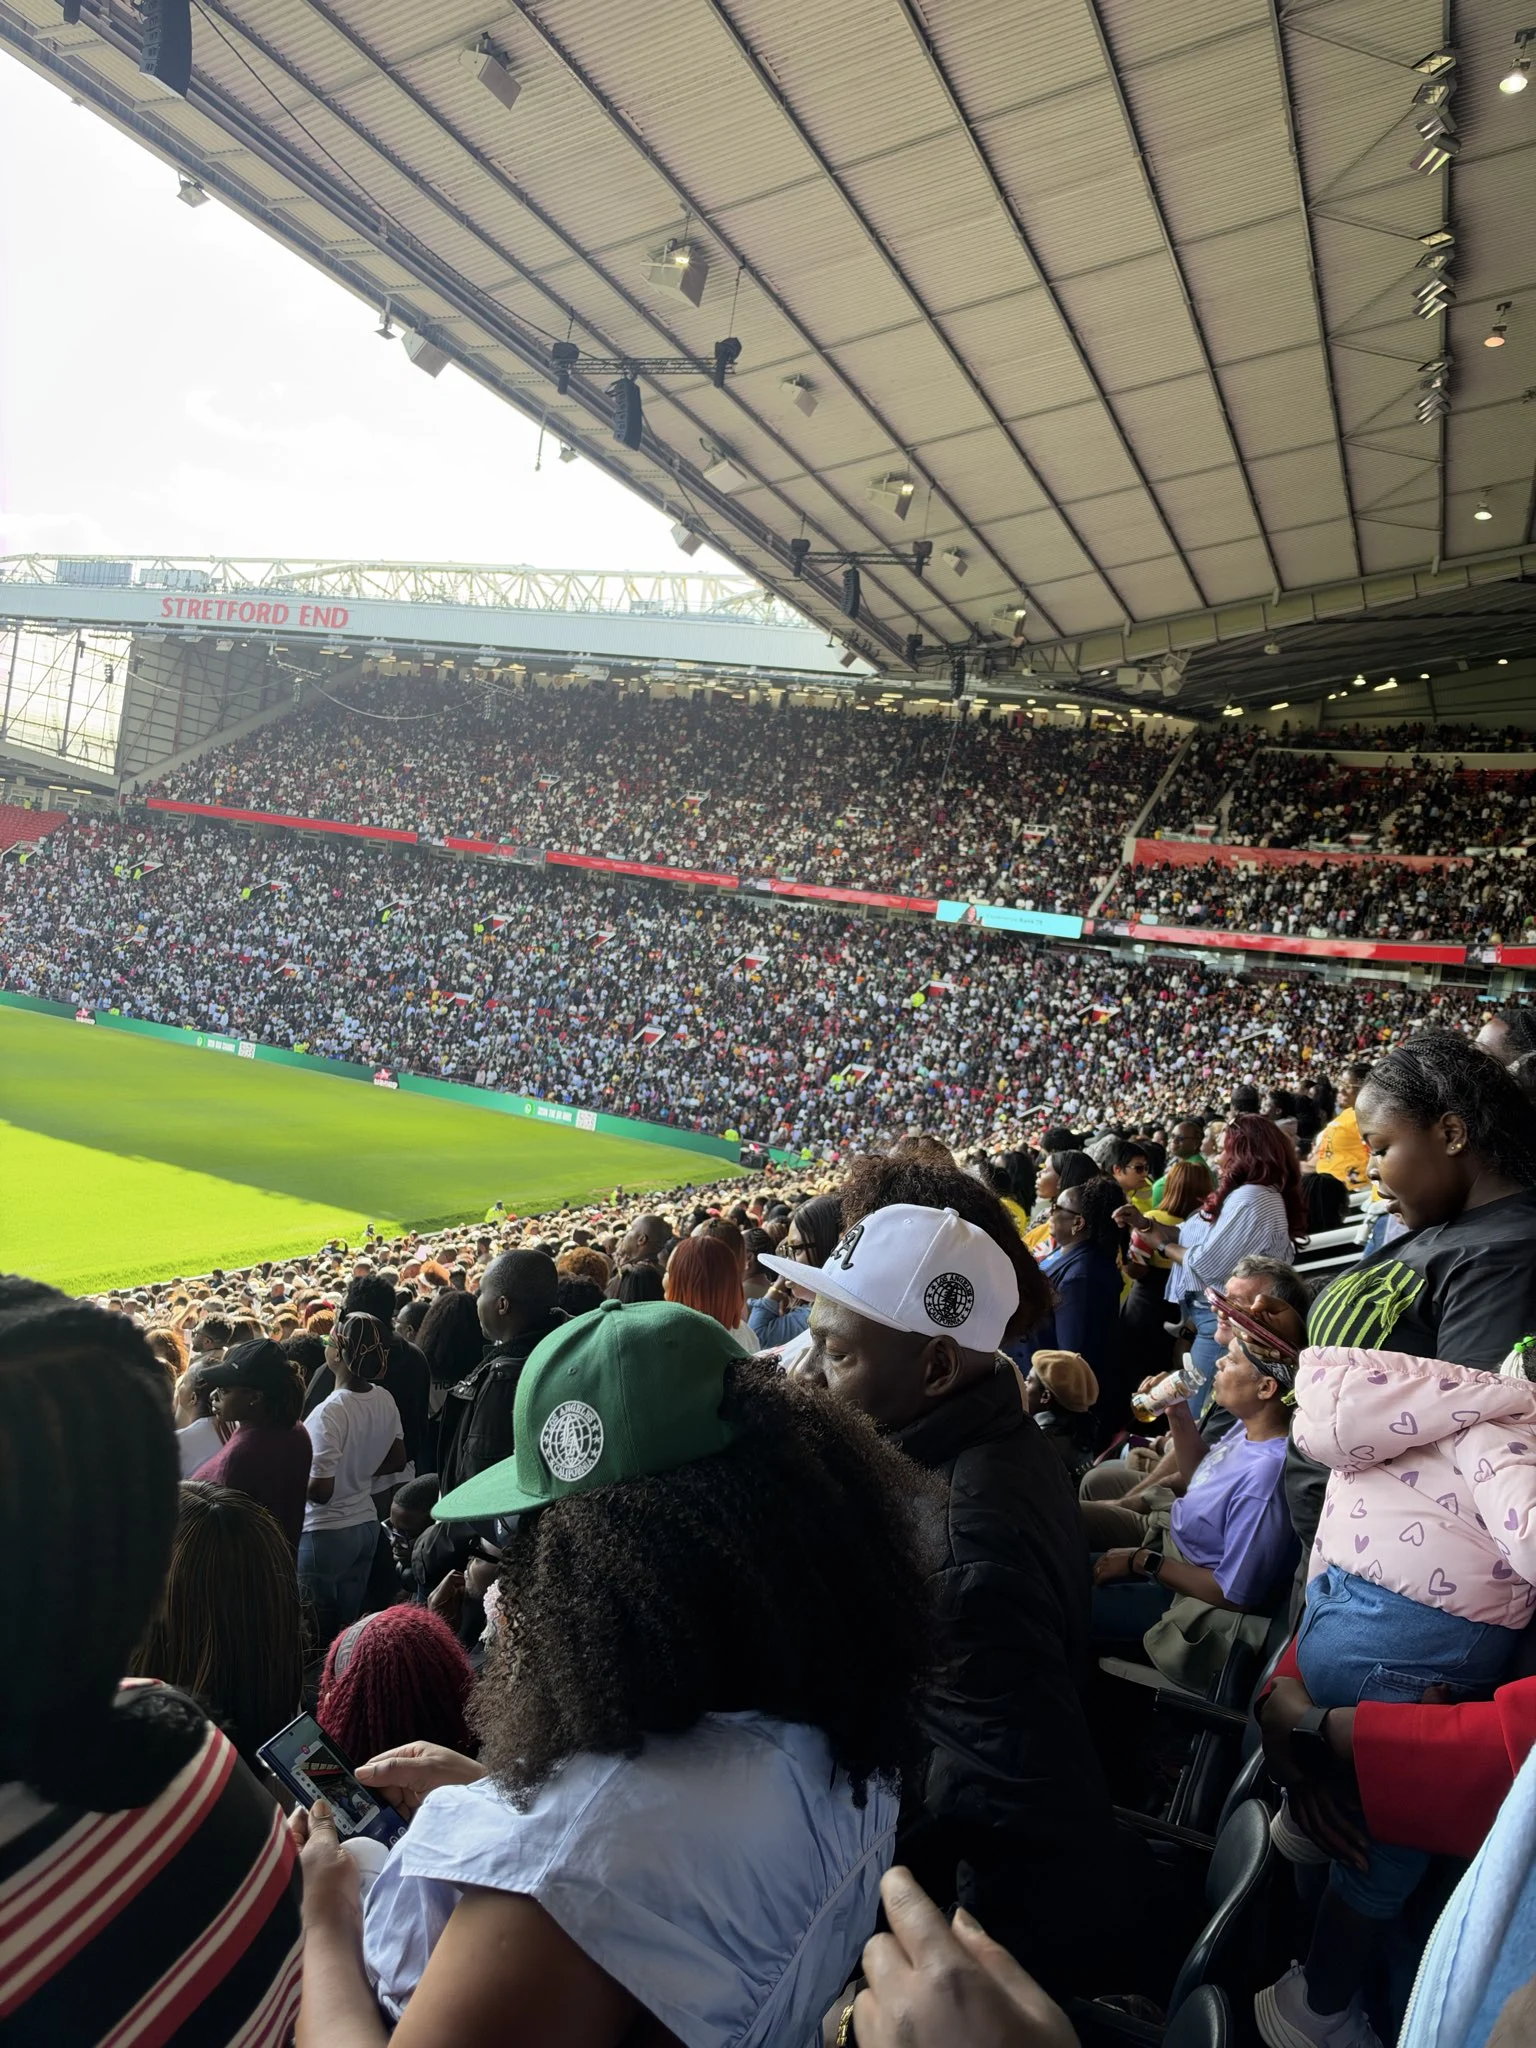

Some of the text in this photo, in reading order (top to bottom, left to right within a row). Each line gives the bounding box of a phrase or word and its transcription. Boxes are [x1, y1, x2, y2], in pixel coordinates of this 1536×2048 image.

[161, 596, 350, 629] STRETFORD END
[935, 1274, 948, 1285] LOS
[928, 1307, 962, 1326] CALIFORNIA
[545, 1402, 596, 1433] LOS ANGELES
[553, 1457, 594, 1479] CALIFORNIA
